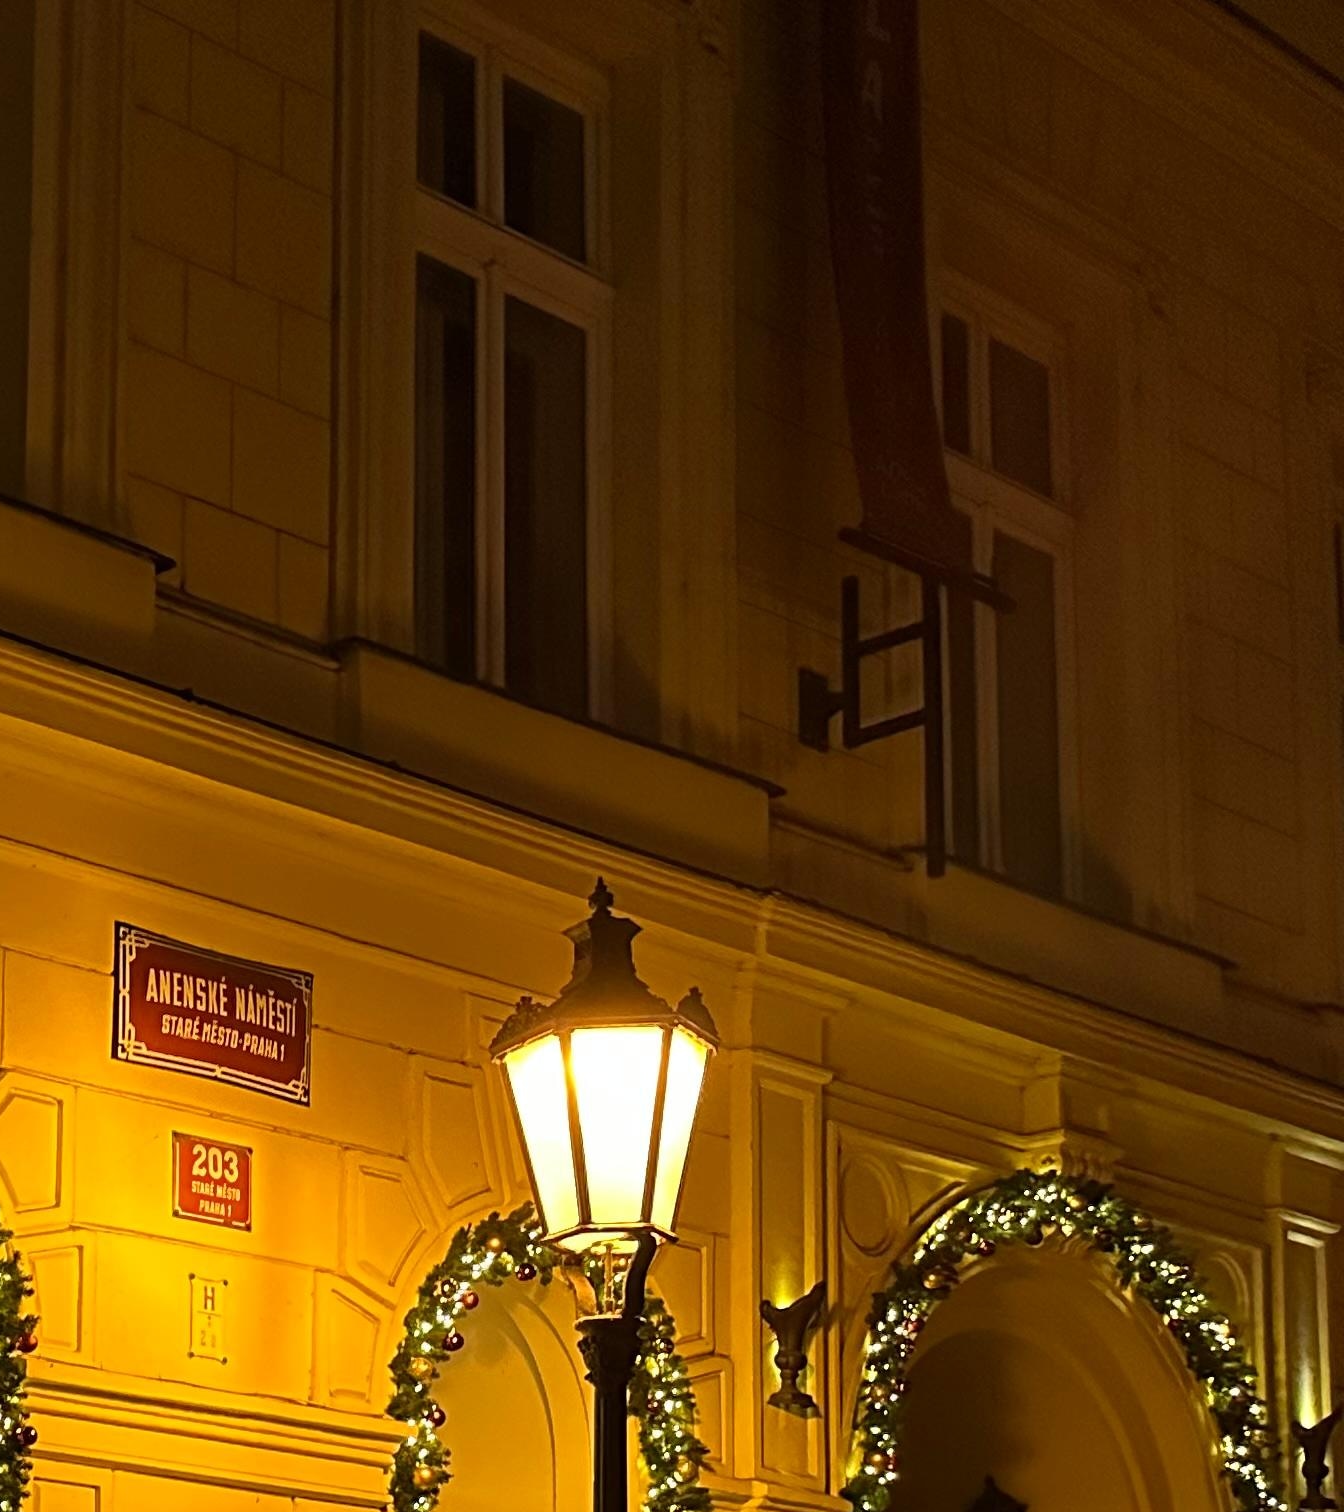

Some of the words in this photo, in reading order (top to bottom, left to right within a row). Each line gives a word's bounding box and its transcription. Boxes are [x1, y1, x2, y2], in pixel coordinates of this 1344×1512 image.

[146, 967, 228, 1017] ANENSKÉ
[235, 983, 297, 1038] NÁMĚSTÍ
[161, 1013, 200, 1041] STARÉ
[192, 1144, 239, 1183] 203
